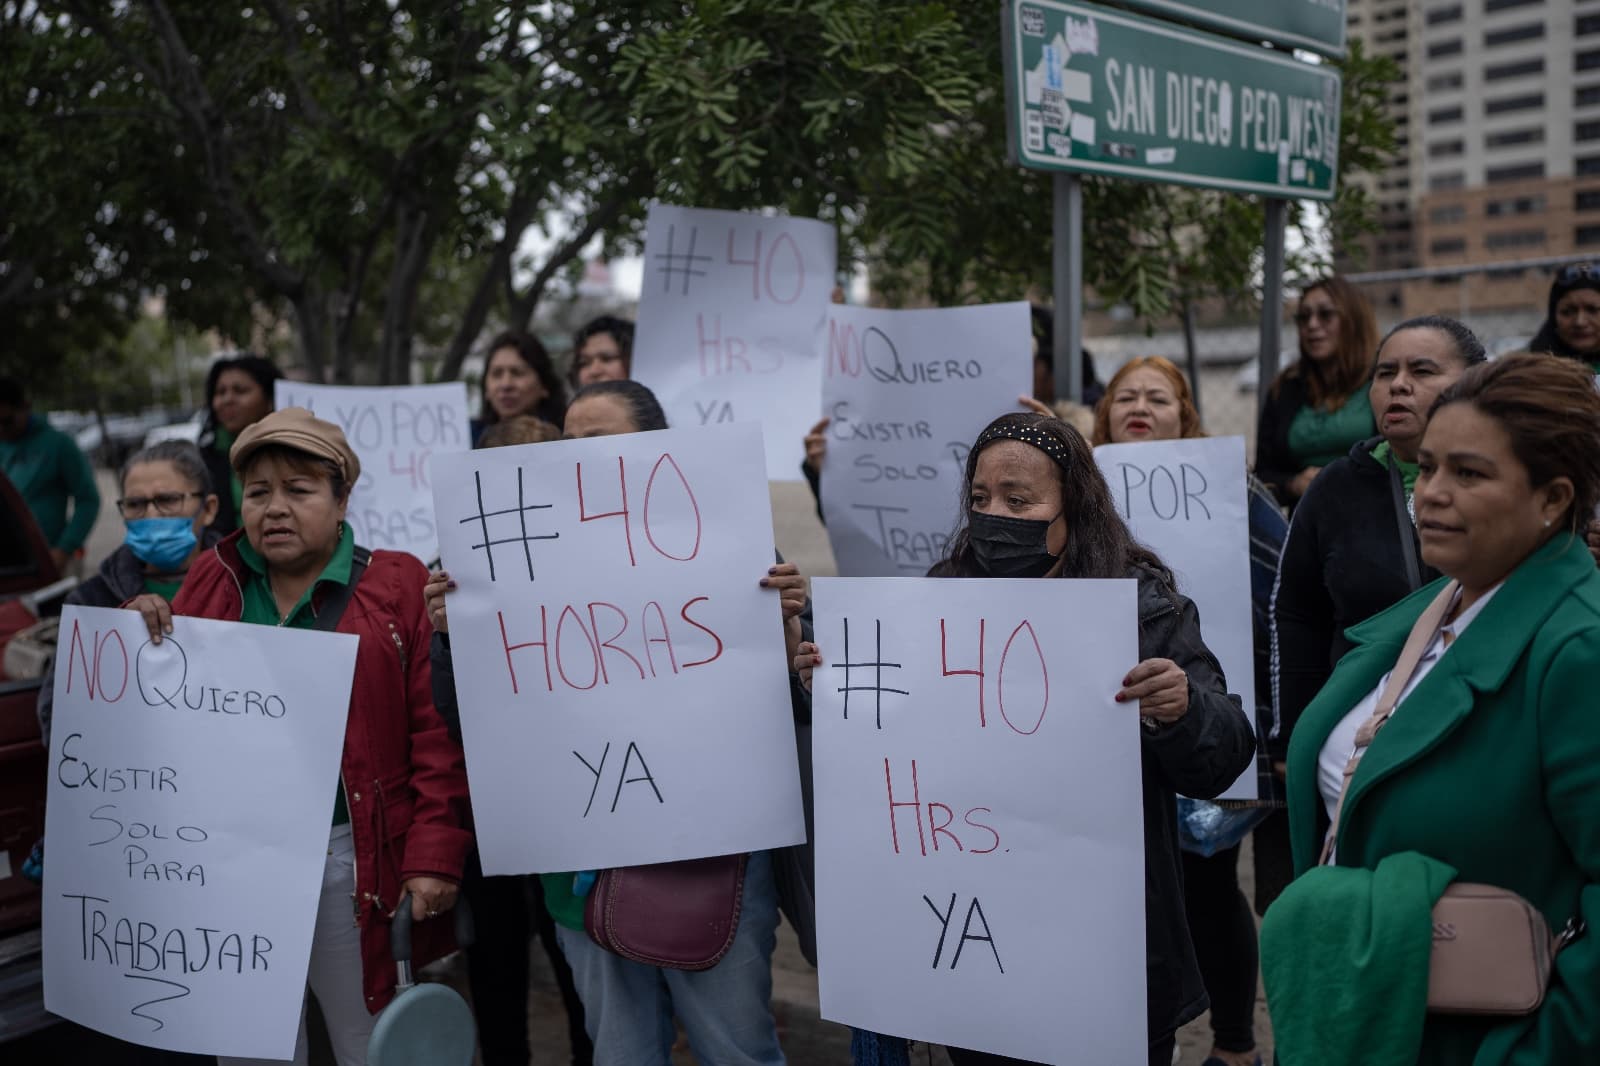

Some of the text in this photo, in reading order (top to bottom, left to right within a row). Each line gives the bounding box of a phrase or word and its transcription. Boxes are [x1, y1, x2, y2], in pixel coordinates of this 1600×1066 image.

[1105, 58, 1155, 136] SAN
[1166, 71, 1233, 147] DIEGO
[1241, 86, 1281, 154] PED
[1287, 94, 1332, 162] WES
[828, 318, 983, 384] NO QUIERO
[391, 402, 461, 446] POR
[832, 401, 933, 442] EXISTIR
[853, 454, 938, 483] SOLO
[1116, 462, 1211, 521] POR
[66, 618, 286, 719] NO QUIERO
[498, 596, 723, 694] HORAS
[58, 733, 178, 793] EXISTIR
[572, 741, 664, 818] YA
[88, 805, 208, 847] SOLO
[124, 845, 206, 886] PARA
[61, 894, 273, 974] TRABAJAR
[922, 892, 1005, 974] YA
